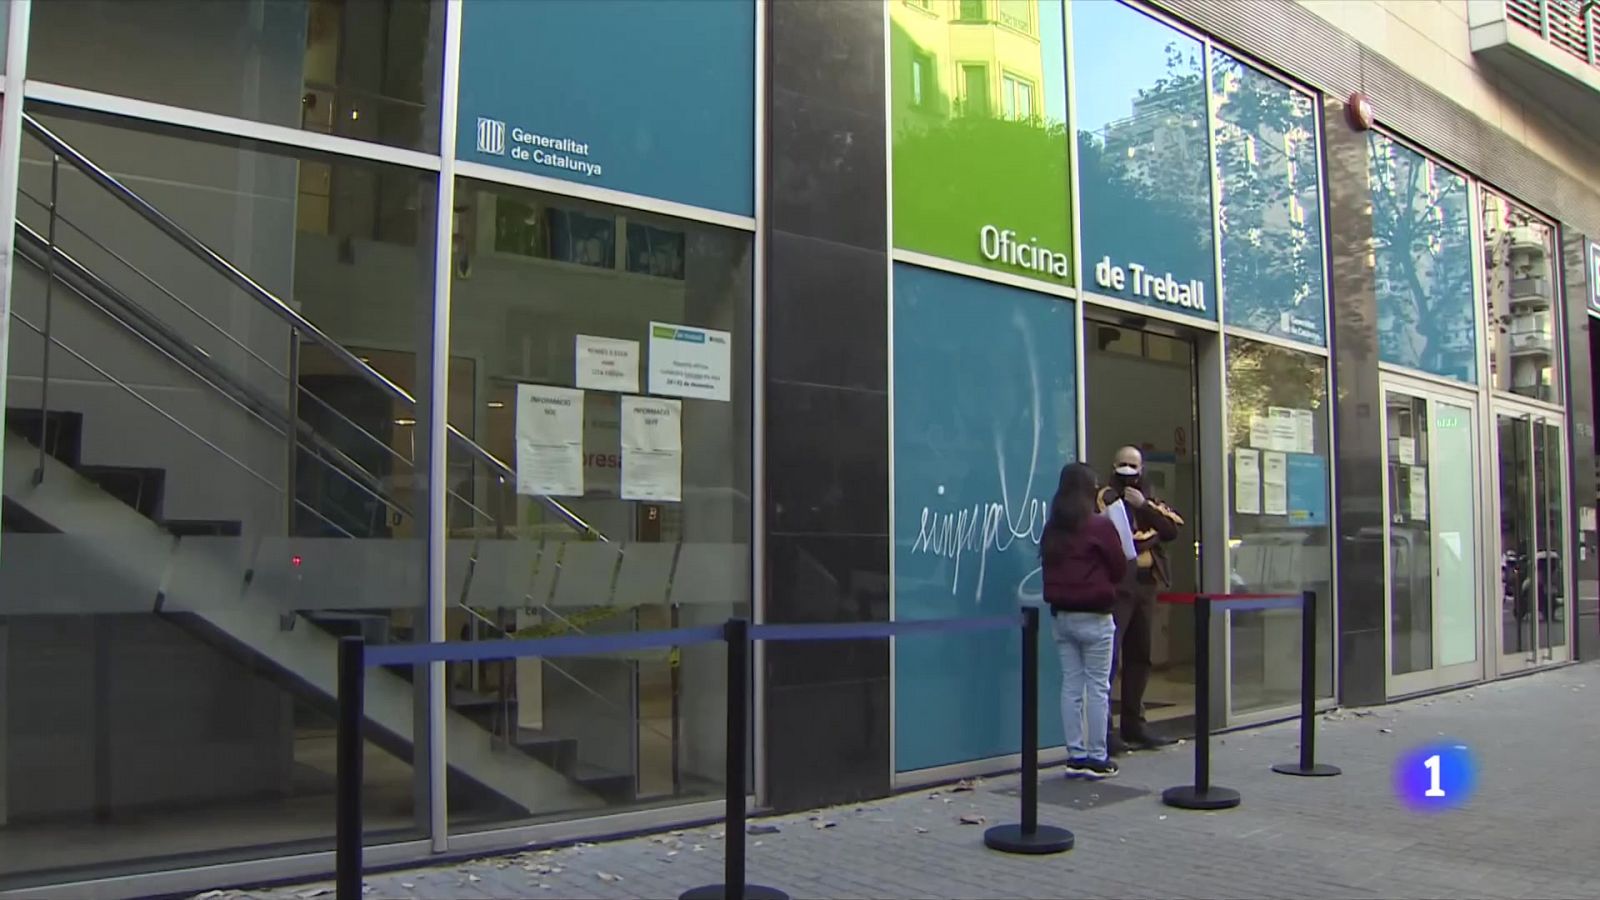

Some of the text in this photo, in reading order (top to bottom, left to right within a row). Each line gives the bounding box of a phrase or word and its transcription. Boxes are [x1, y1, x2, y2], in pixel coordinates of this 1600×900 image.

[511, 127, 589, 156] Generalitat
[511, 146, 602, 176] de Catalunya
[980, 224, 1207, 311] Oficina de Treball
